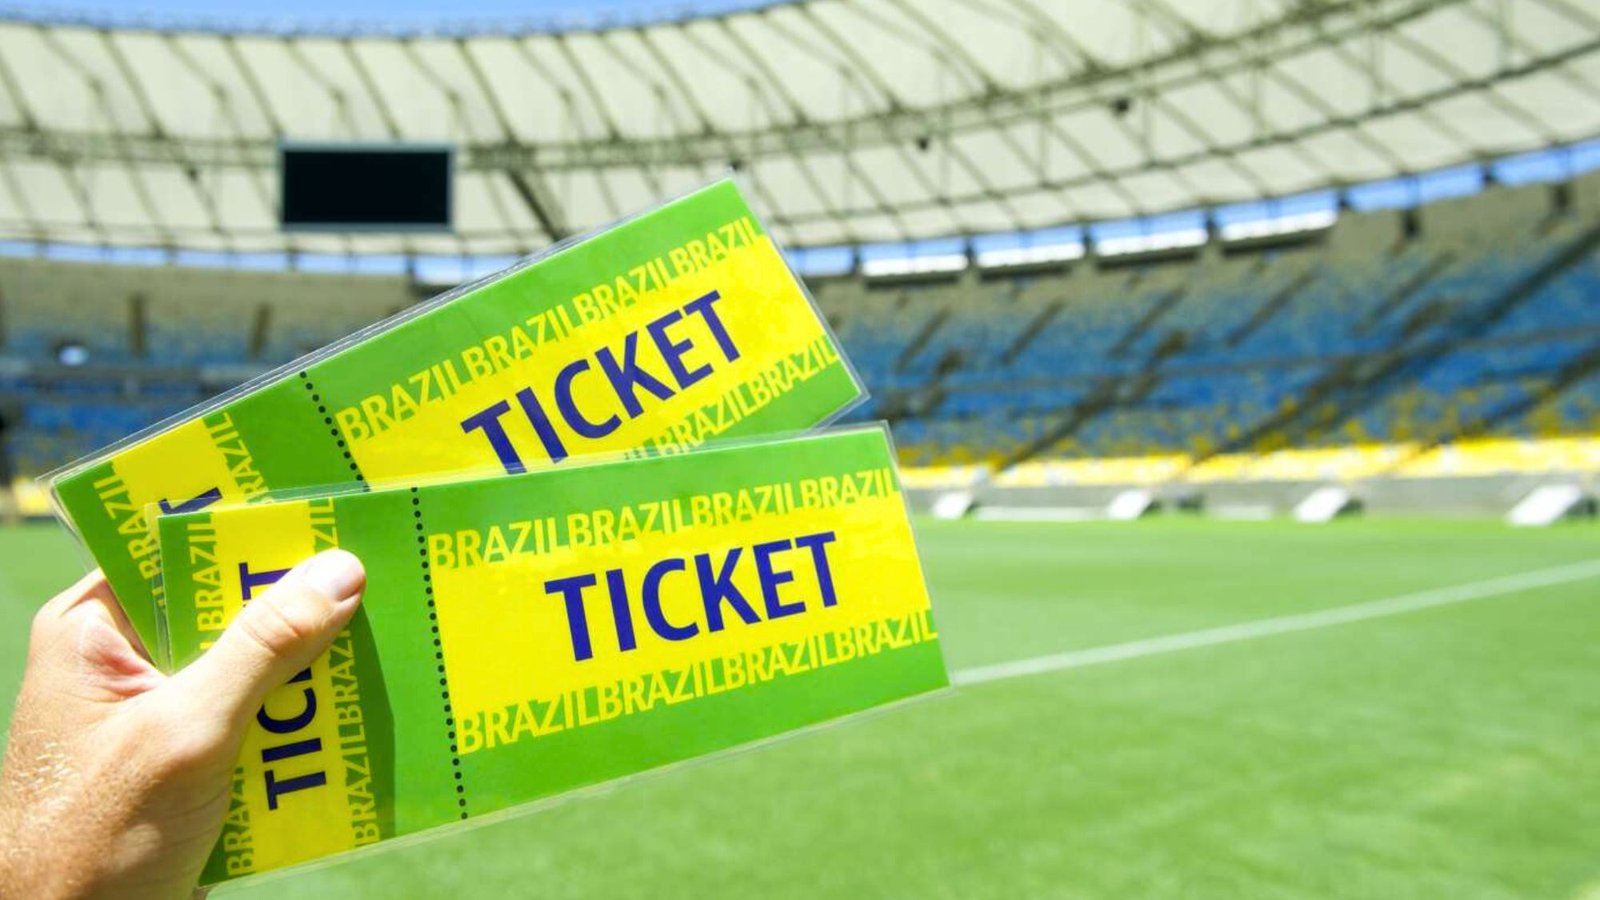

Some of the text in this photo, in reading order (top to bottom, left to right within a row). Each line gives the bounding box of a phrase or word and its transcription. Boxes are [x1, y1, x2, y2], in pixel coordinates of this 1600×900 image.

[461, 290, 742, 475] TICKET
[193, 514, 229, 649] BRAZIL
[544, 531, 838, 662] TICKET
